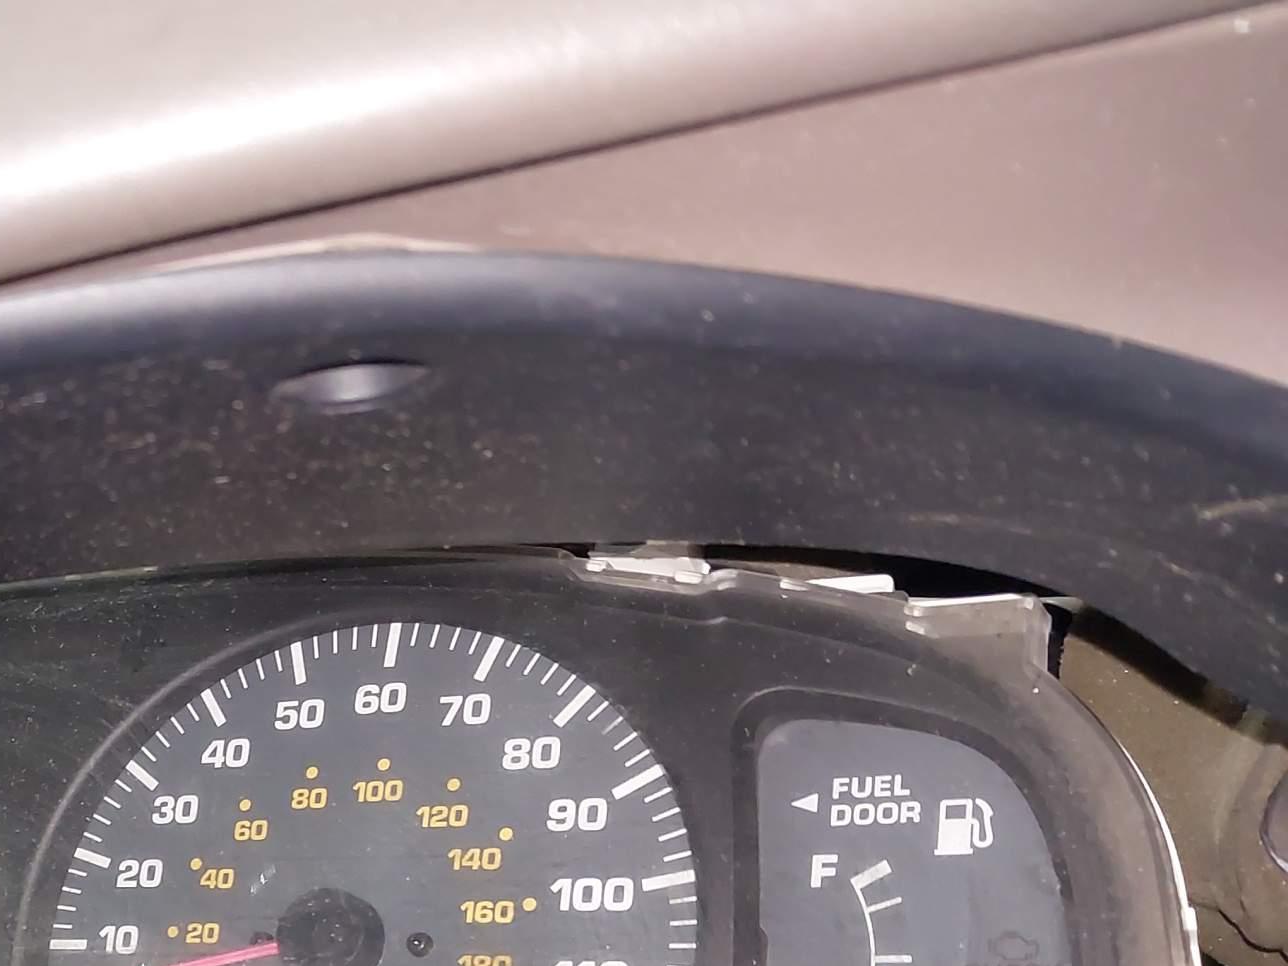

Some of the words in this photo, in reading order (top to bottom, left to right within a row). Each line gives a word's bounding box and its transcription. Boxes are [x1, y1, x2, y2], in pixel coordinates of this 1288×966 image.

[275, 698, 324, 729] 50
[354, 683, 407, 715] 60
[439, 693, 491, 726] 70
[202, 738, 250, 769] 40
[502, 736, 560, 770] 80
[291, 788, 327, 809] 80
[353, 780, 402, 802] 100
[832, 774, 910, 800] FUEL
[152, 795, 198, 825] 30
[416, 805, 468, 828] 120
[546, 798, 607, 832] 90
[830, 800, 921, 826] DOOR
[234, 820, 268, 841] 60
[117, 859, 163, 889] 20
[448, 848, 501, 871] 140
[811, 854, 839, 888] F
[199, 868, 234, 890] 40
[550, 878, 633, 912] 100
[460, 901, 514, 924] 160
[98, 925, 139, 954] 10
[185, 923, 220, 944] 20
